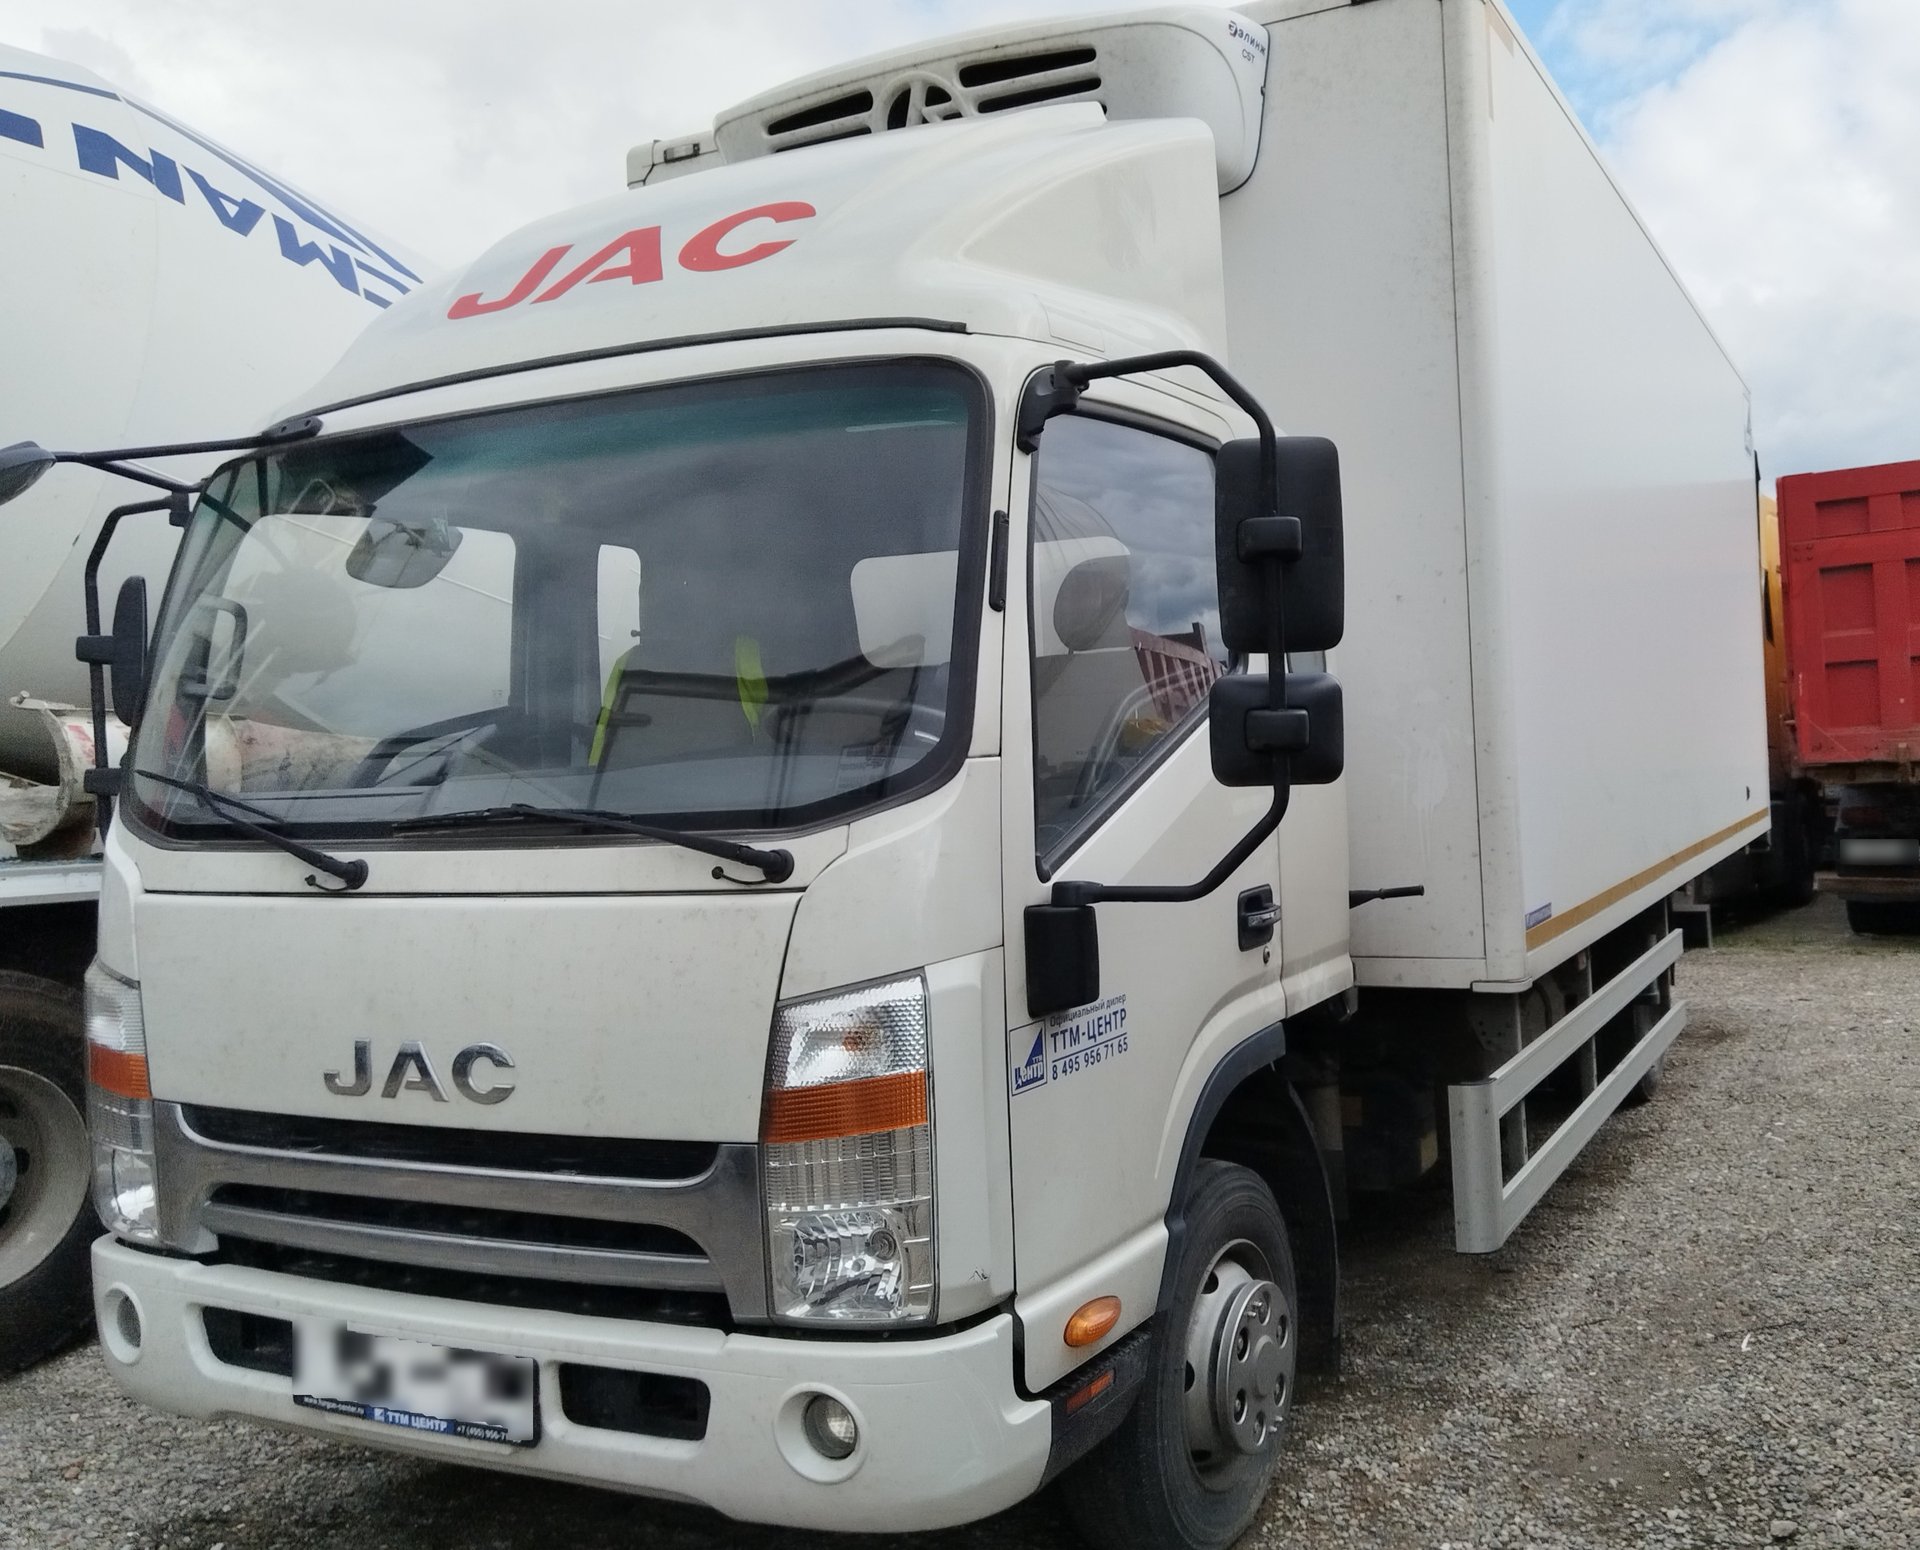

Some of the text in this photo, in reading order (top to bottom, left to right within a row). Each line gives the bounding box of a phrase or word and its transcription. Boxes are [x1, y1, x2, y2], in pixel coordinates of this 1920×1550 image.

[1241, 48, 1256, 63] CST
[447, 201, 817, 320] JAC
[1050, 994, 1127, 1028] Официальный дилер
[1050, 1008, 1127, 1053] ТТМ-ЦЕНТР
[323, 1037, 516, 1105] JAC
[1052, 1036, 1128, 1080] 8 495 956 71 65
[387, 1410, 448, 1432] ТТМ ЦЕНТР
